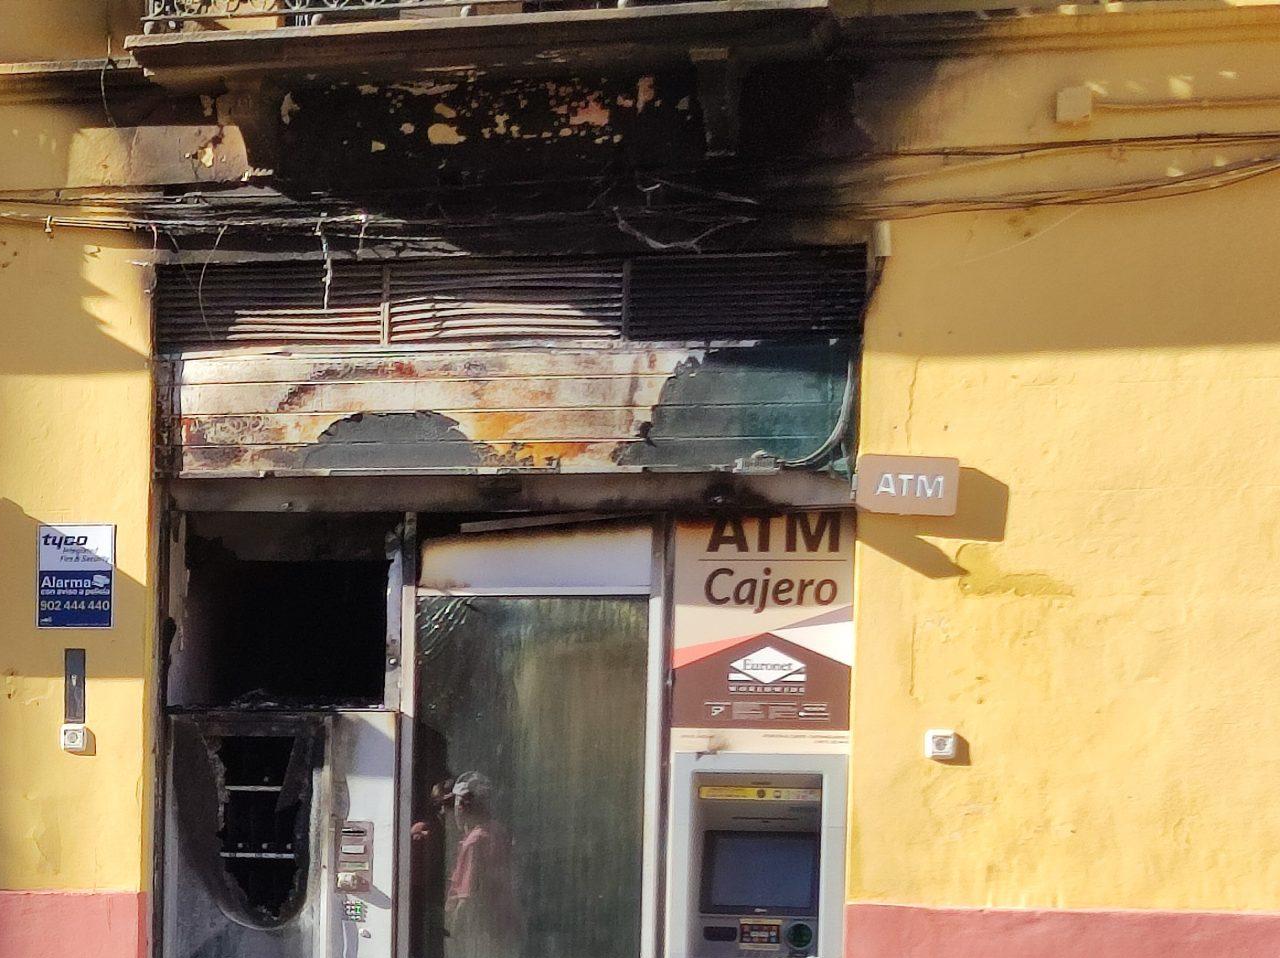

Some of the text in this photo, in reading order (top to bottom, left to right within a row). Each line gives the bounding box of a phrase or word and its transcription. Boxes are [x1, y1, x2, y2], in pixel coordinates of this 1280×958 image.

[875, 473, 945, 499] ATM
[42, 533, 88, 550] tyco
[706, 512, 841, 552] ATM
[41, 576, 91, 588] Alarma
[704, 567, 838, 613] Cajero
[40, 600, 110, 611] 902 444 440
